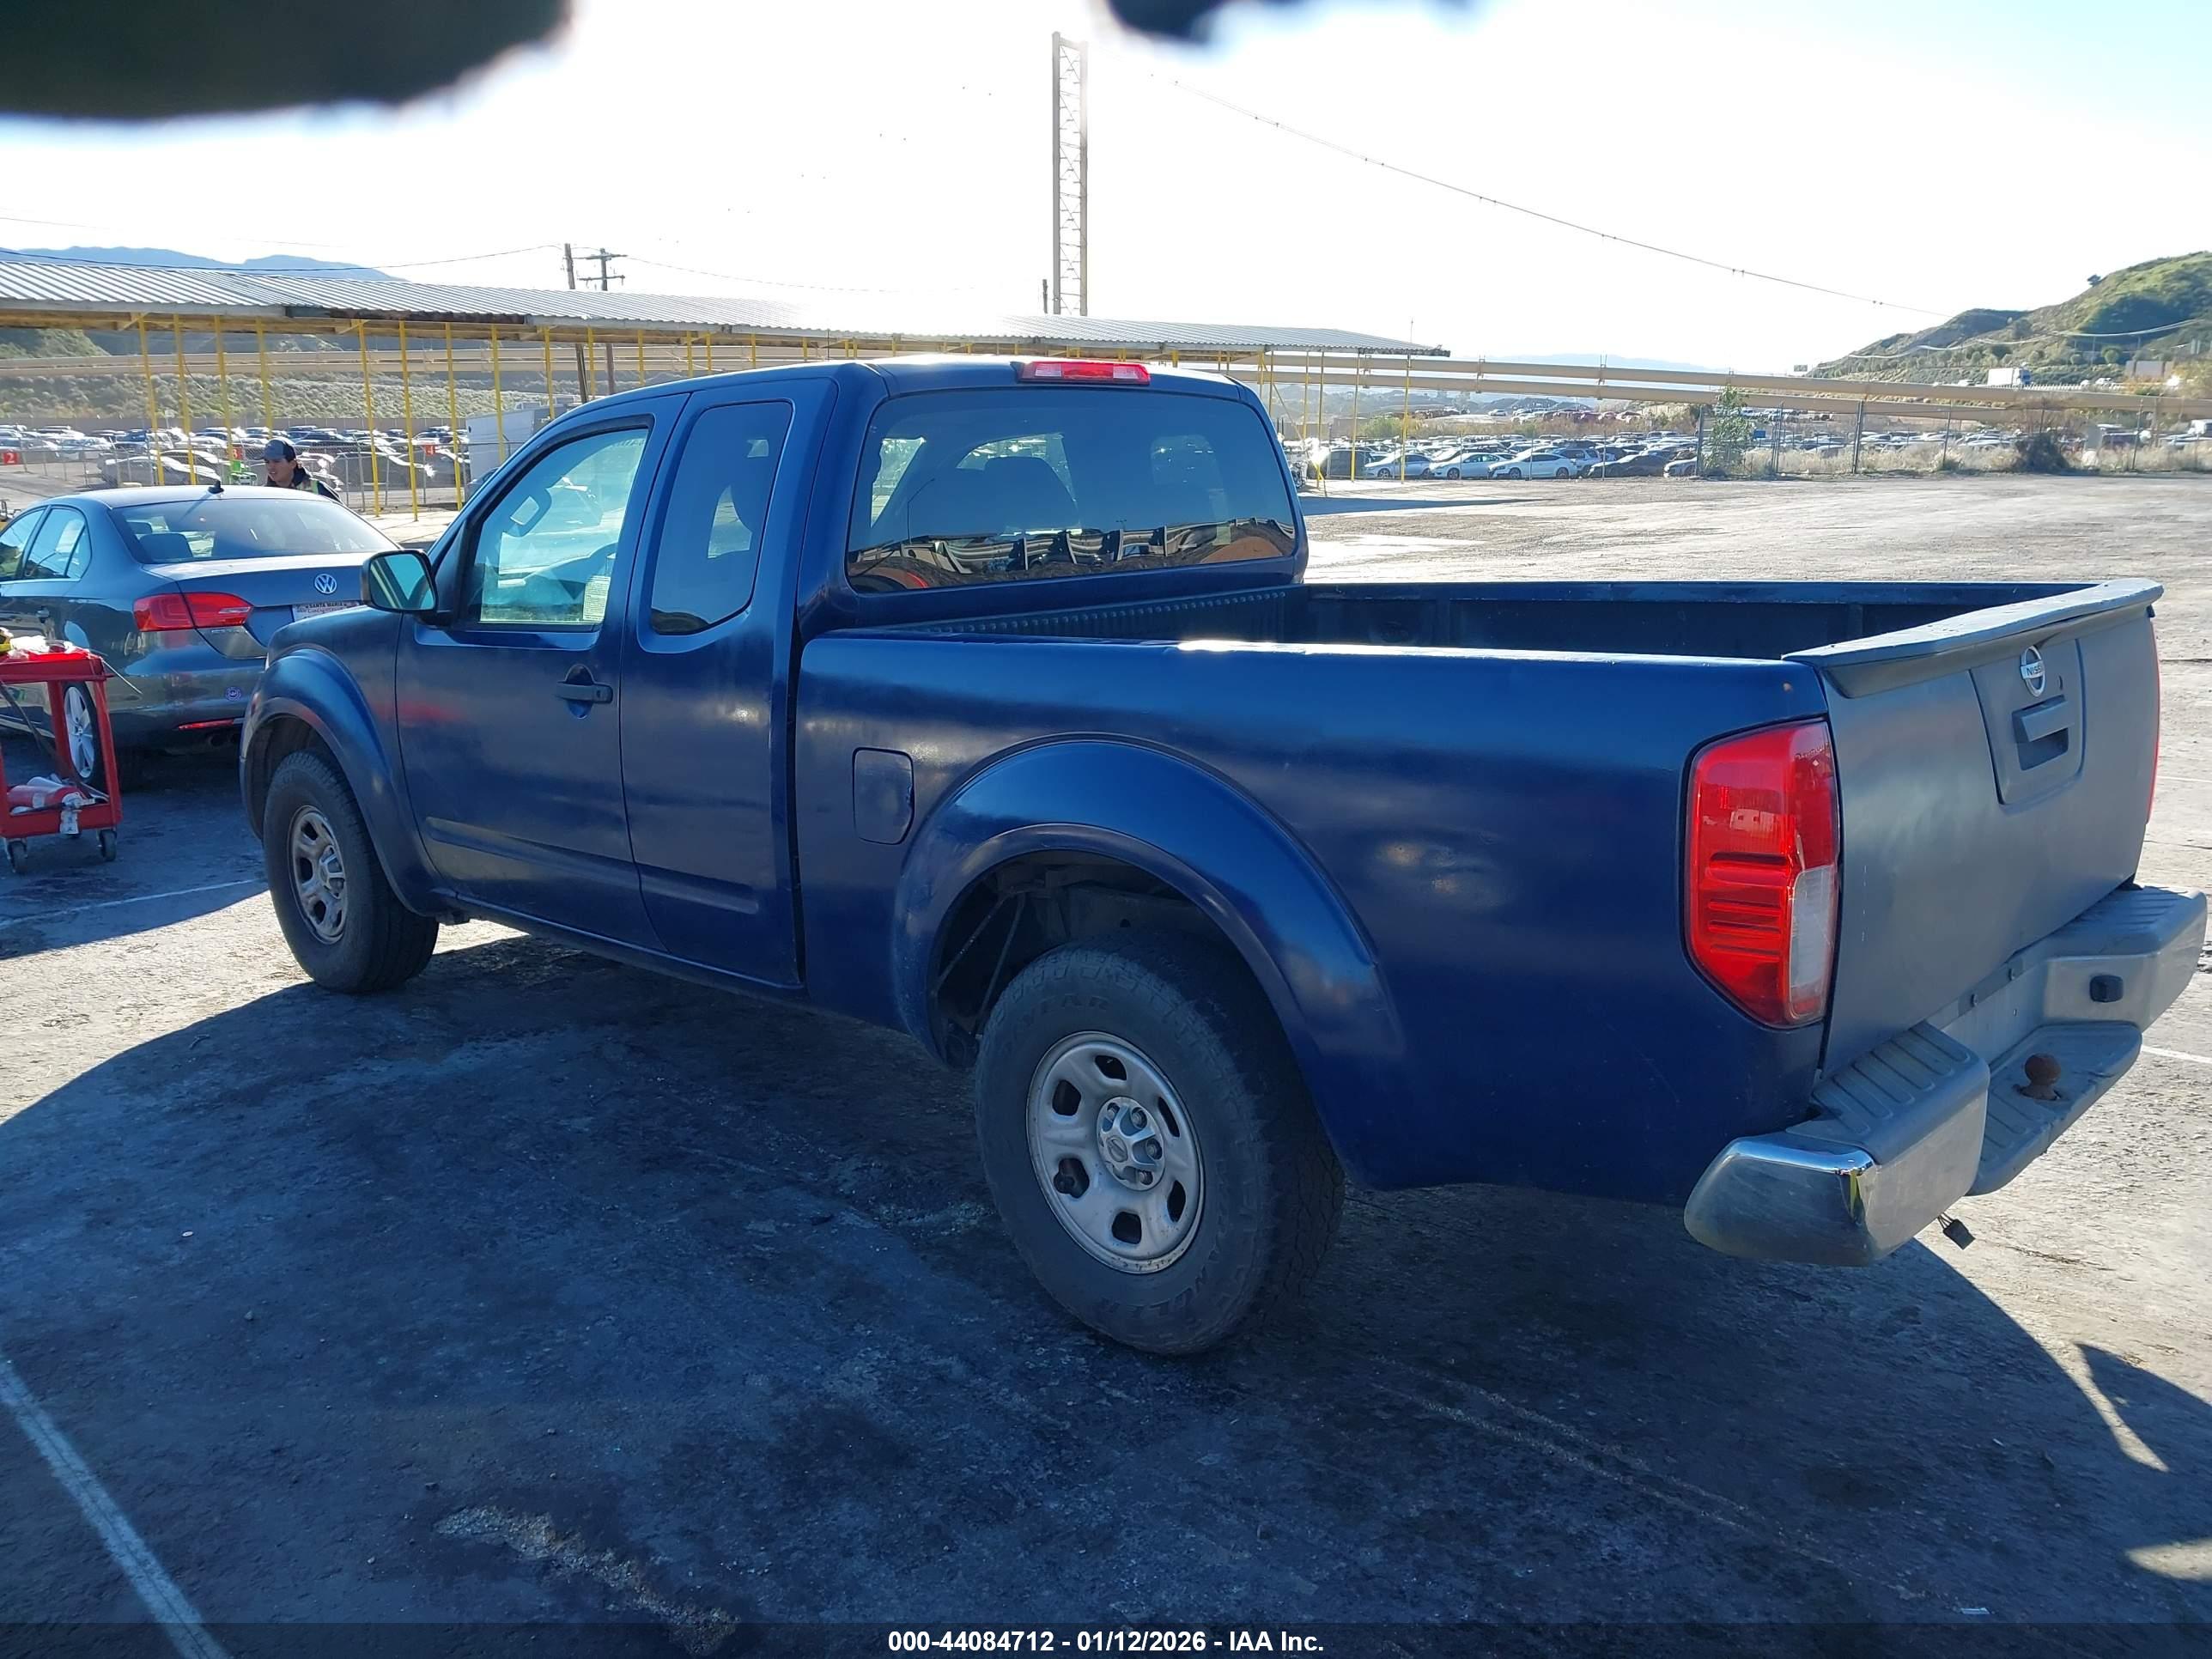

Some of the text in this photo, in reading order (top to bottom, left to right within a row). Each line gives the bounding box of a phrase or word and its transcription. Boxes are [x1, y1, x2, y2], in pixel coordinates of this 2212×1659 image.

[427, 445, 433, 455] 4
[7, 453, 15, 463] 2
[314, 573, 337, 594] VW
